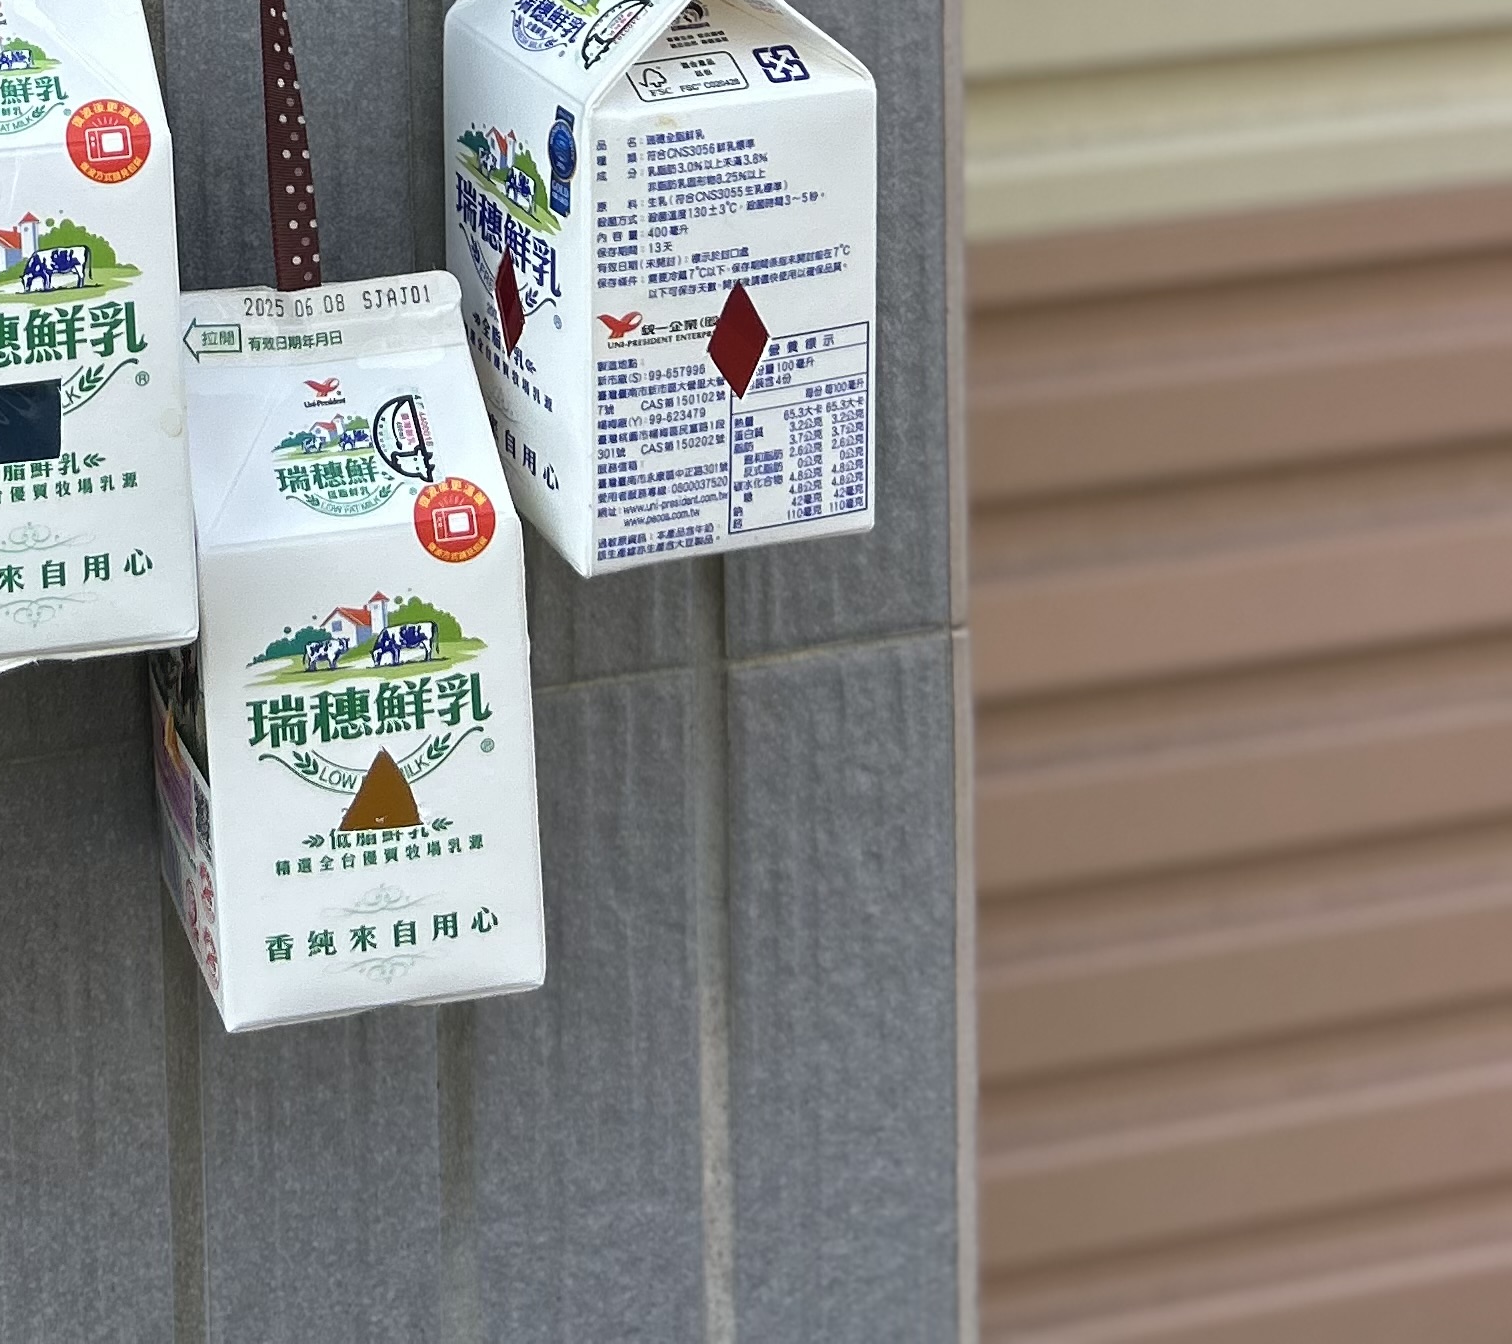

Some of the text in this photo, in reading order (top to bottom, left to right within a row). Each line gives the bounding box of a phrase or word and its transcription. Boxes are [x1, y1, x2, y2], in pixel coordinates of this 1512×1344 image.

[12, 115, 35, 132] MILK
[455, 172, 561, 298] 瑞穗鮮乳
[244, 297, 285, 318] 2025
[295, 298, 314, 317] 06
[324, 293, 345, 313] 08
[202, 331, 235, 347] 拉開
[248, 330, 343, 351] 有效日期年月日
[246, 672, 493, 749] 瑞穗鮮乳
[319, 768, 356, 789] LOW
[266, 906, 499, 962] 香純來自用心
